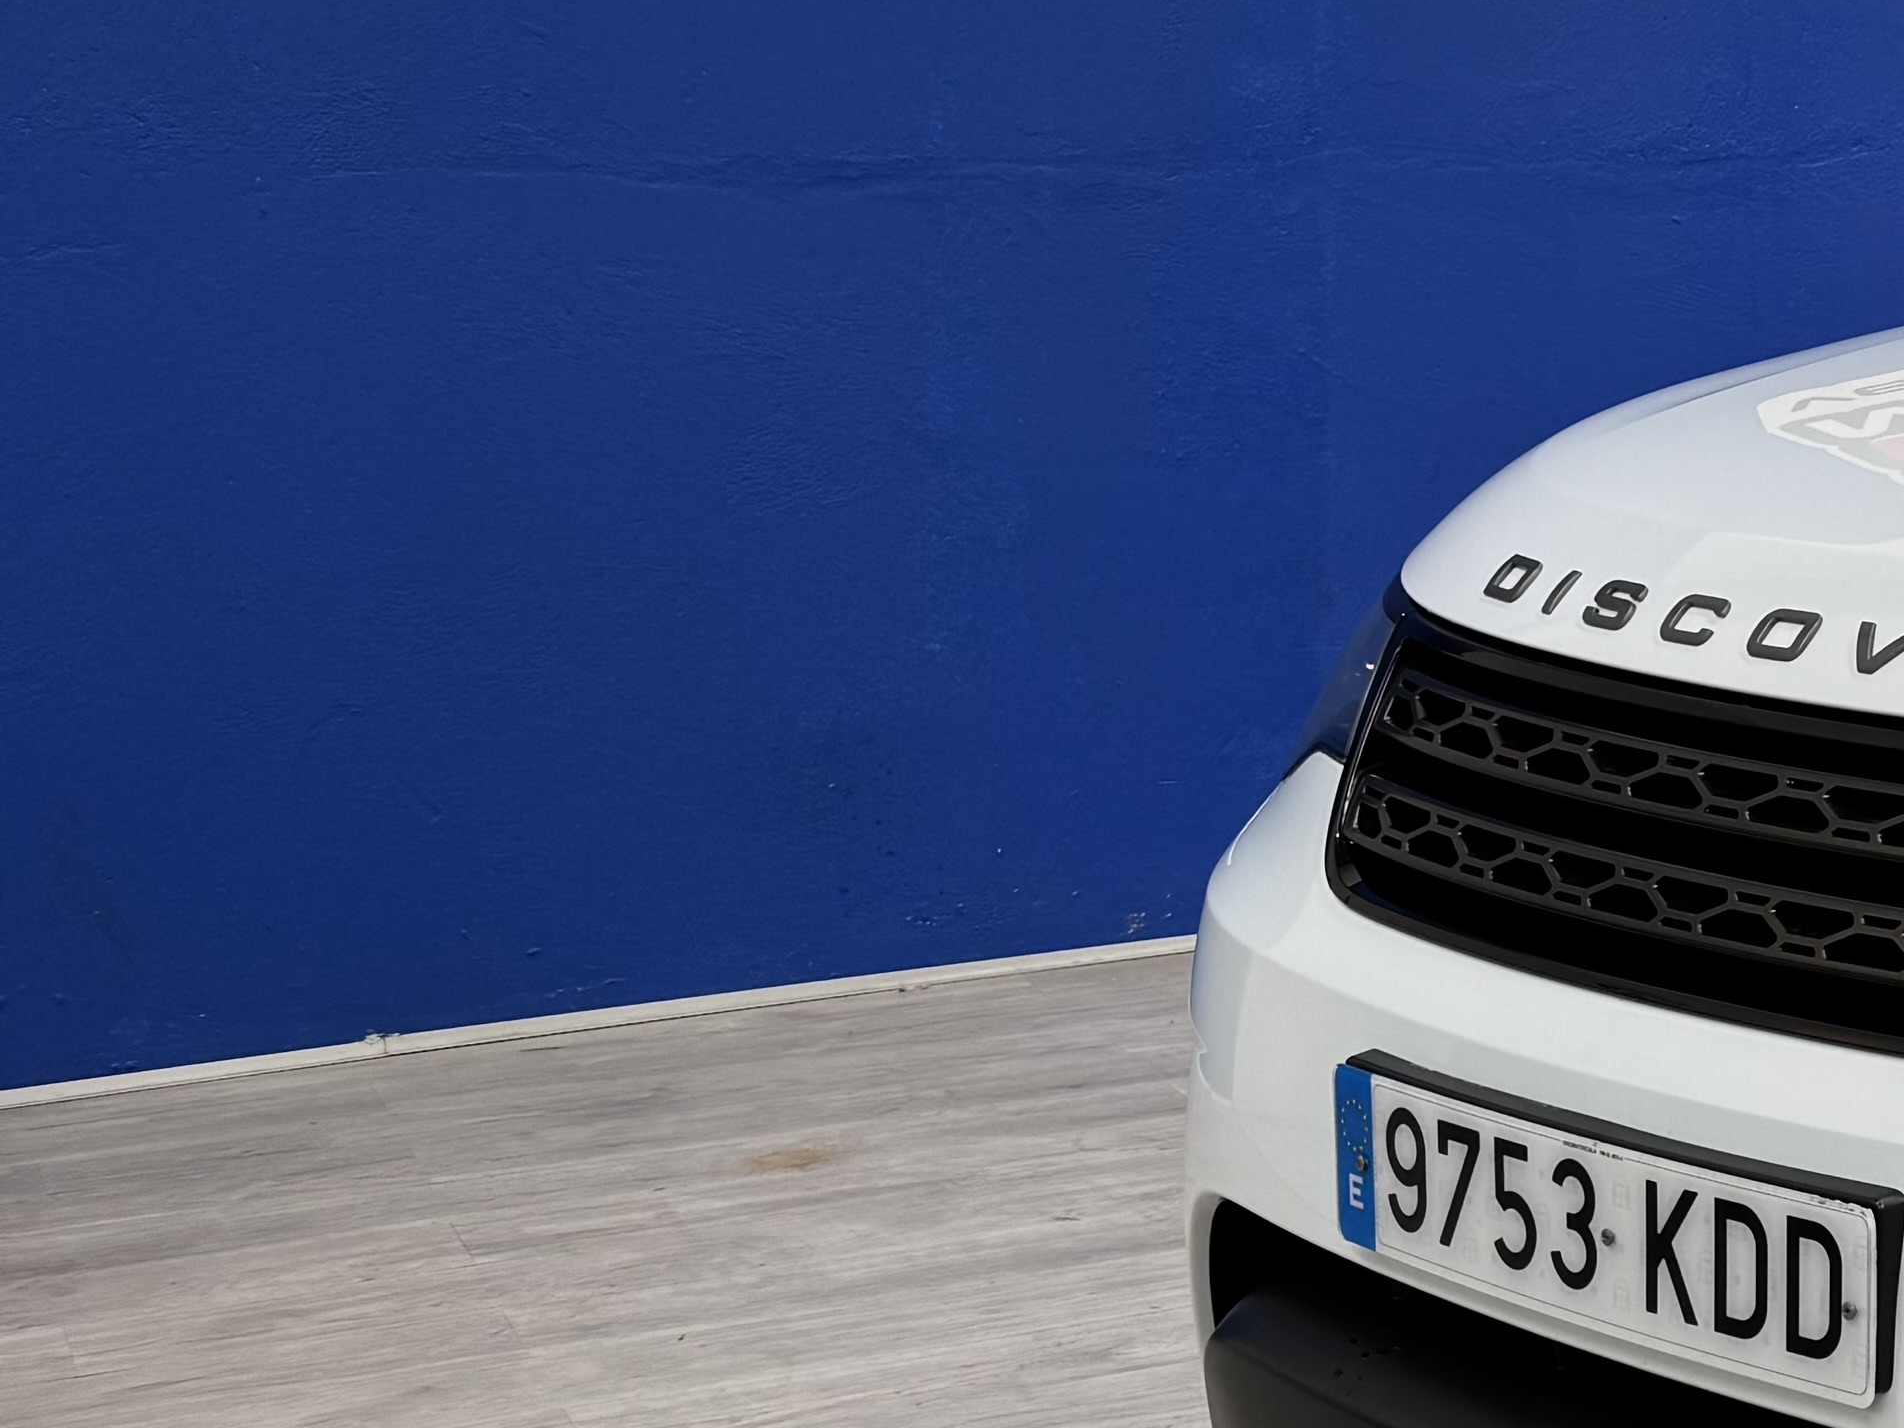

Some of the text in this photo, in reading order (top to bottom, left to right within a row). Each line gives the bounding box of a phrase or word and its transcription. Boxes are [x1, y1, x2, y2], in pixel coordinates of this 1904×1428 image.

[1348, 1173, 1365, 1210] E
[1385, 1107, 1843, 1360] 9753 KDD
